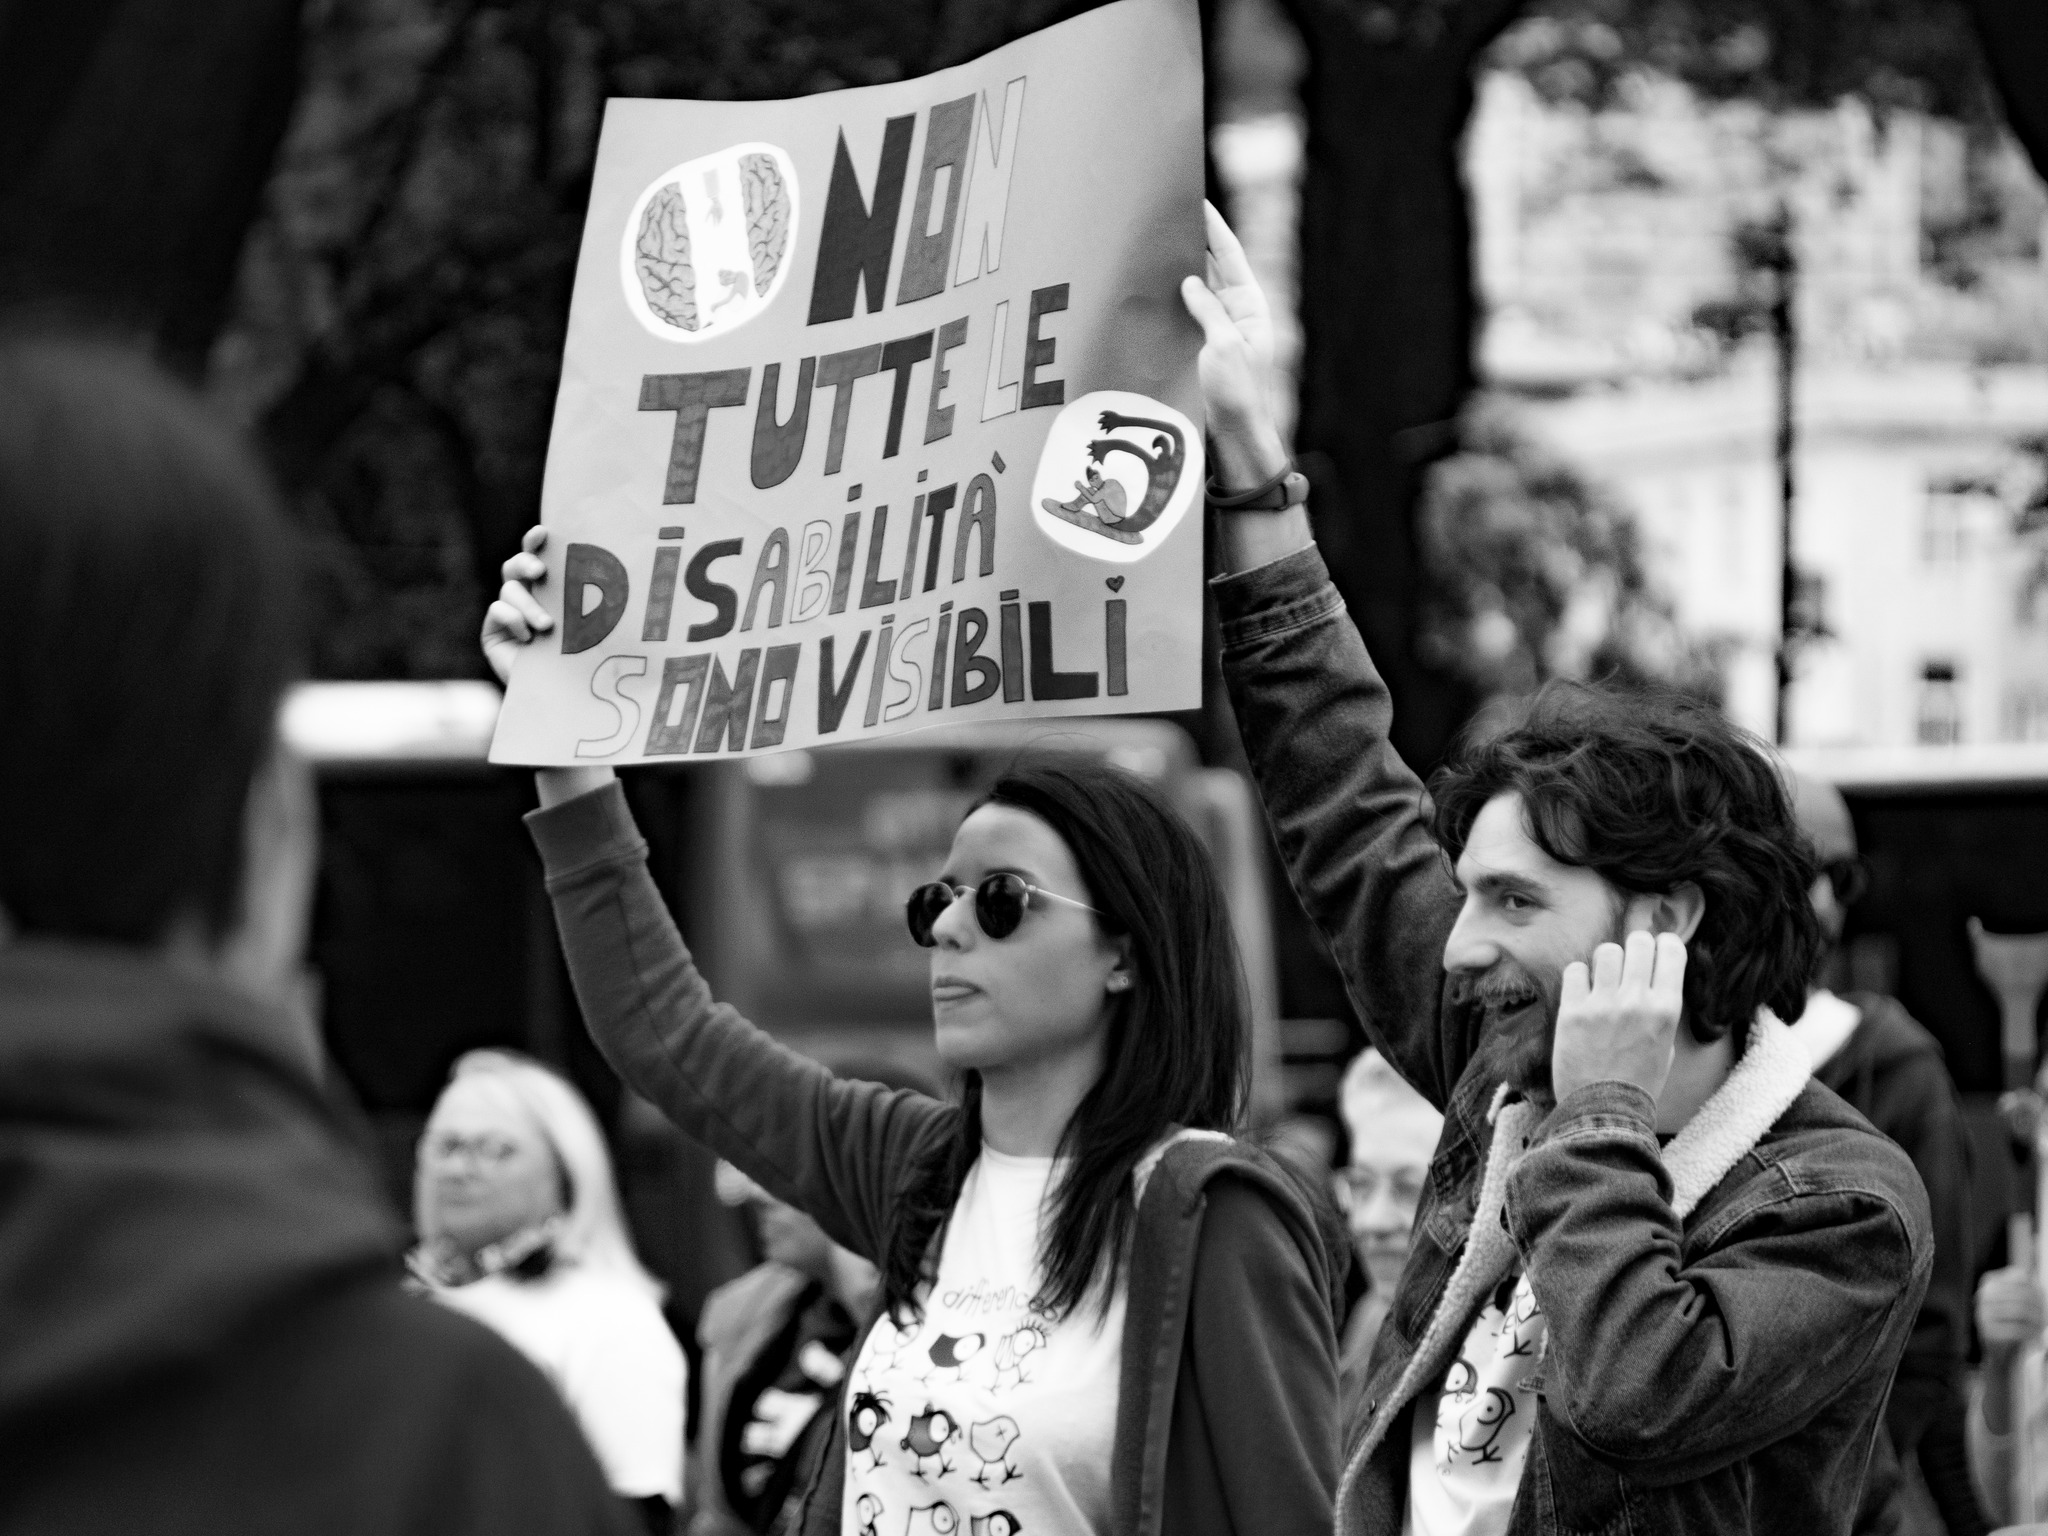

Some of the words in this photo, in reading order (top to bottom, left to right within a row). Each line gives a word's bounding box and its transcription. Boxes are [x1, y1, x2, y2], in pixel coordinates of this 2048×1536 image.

[806, 75, 1027, 327] NON
[637, 315, 970, 506] TUTTE
[980, 283, 1070, 423] LE
[574, 643, 802, 758] SONO
